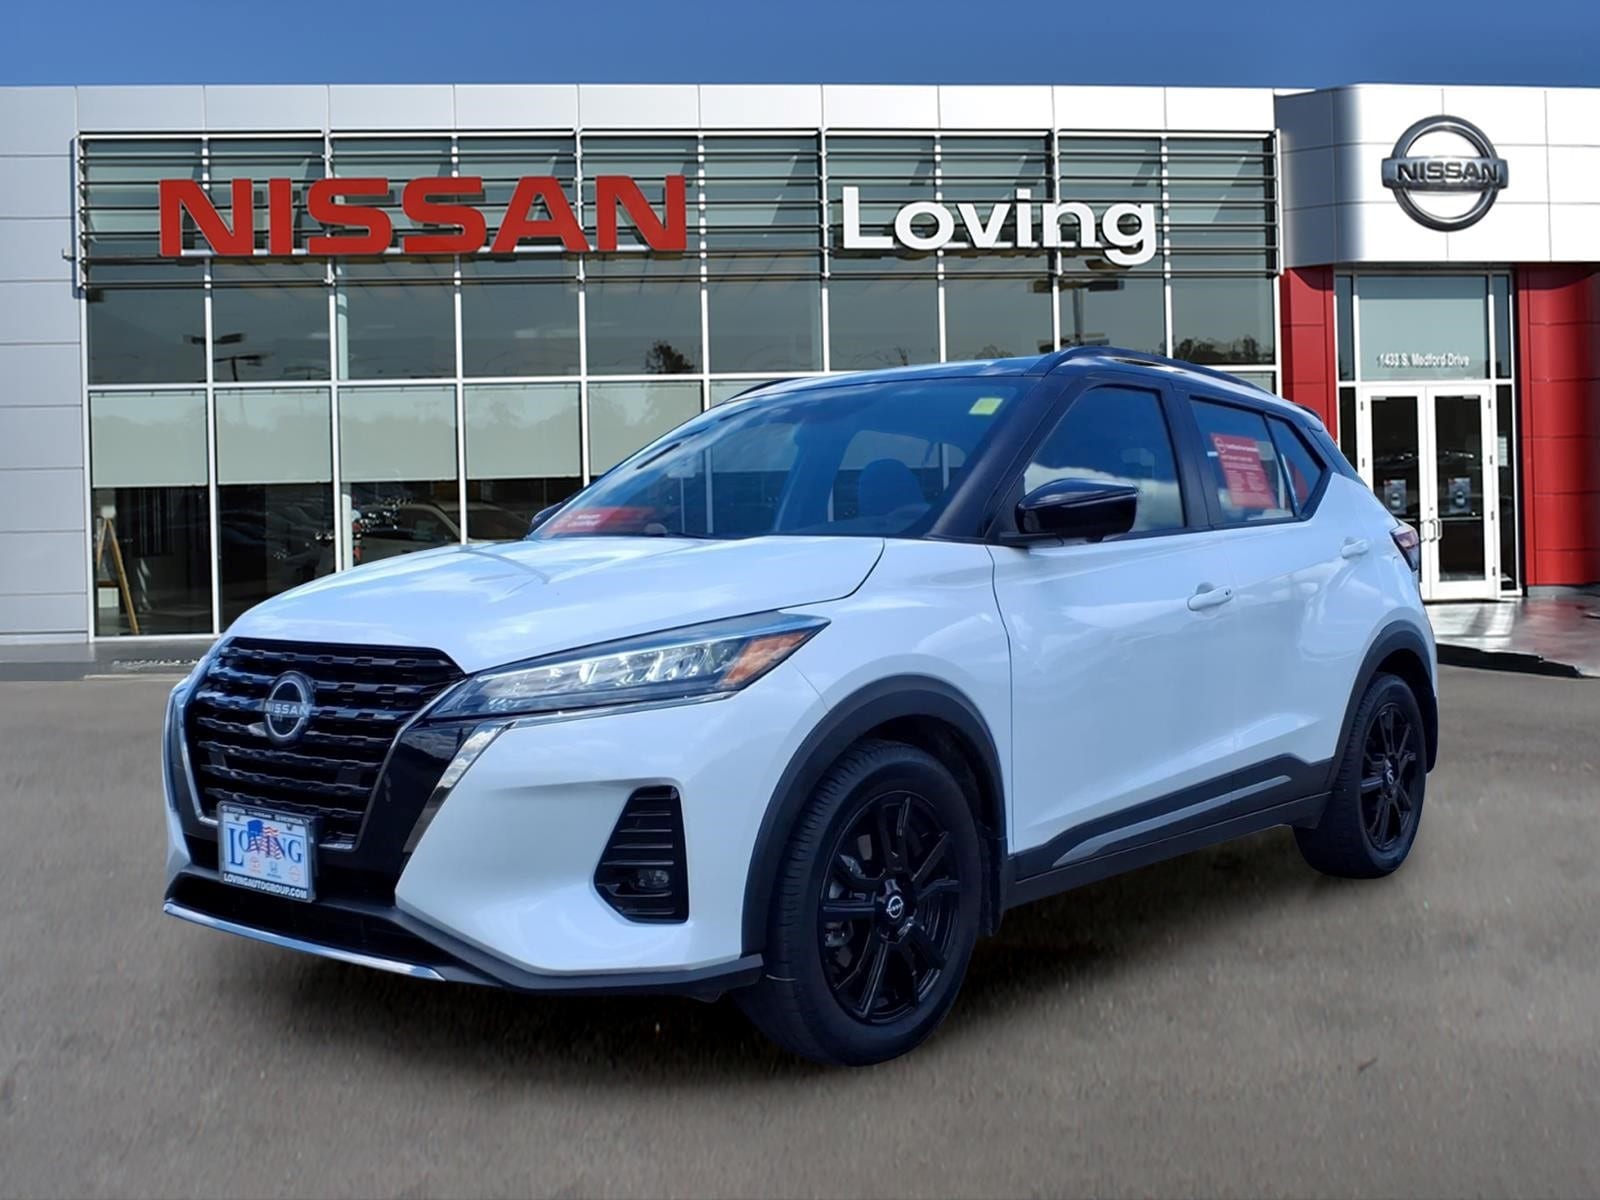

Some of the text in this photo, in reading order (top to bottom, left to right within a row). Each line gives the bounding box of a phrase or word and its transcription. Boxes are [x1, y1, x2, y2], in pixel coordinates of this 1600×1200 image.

[1396, 161, 1499, 182] NISSAN
[159, 175, 687, 256] NISSAN
[842, 186, 1157, 266] Loving
[1447, 352, 1470, 366] Drive
[265, 702, 310, 718] NISSAN
[228, 827, 303, 866] LOVING
